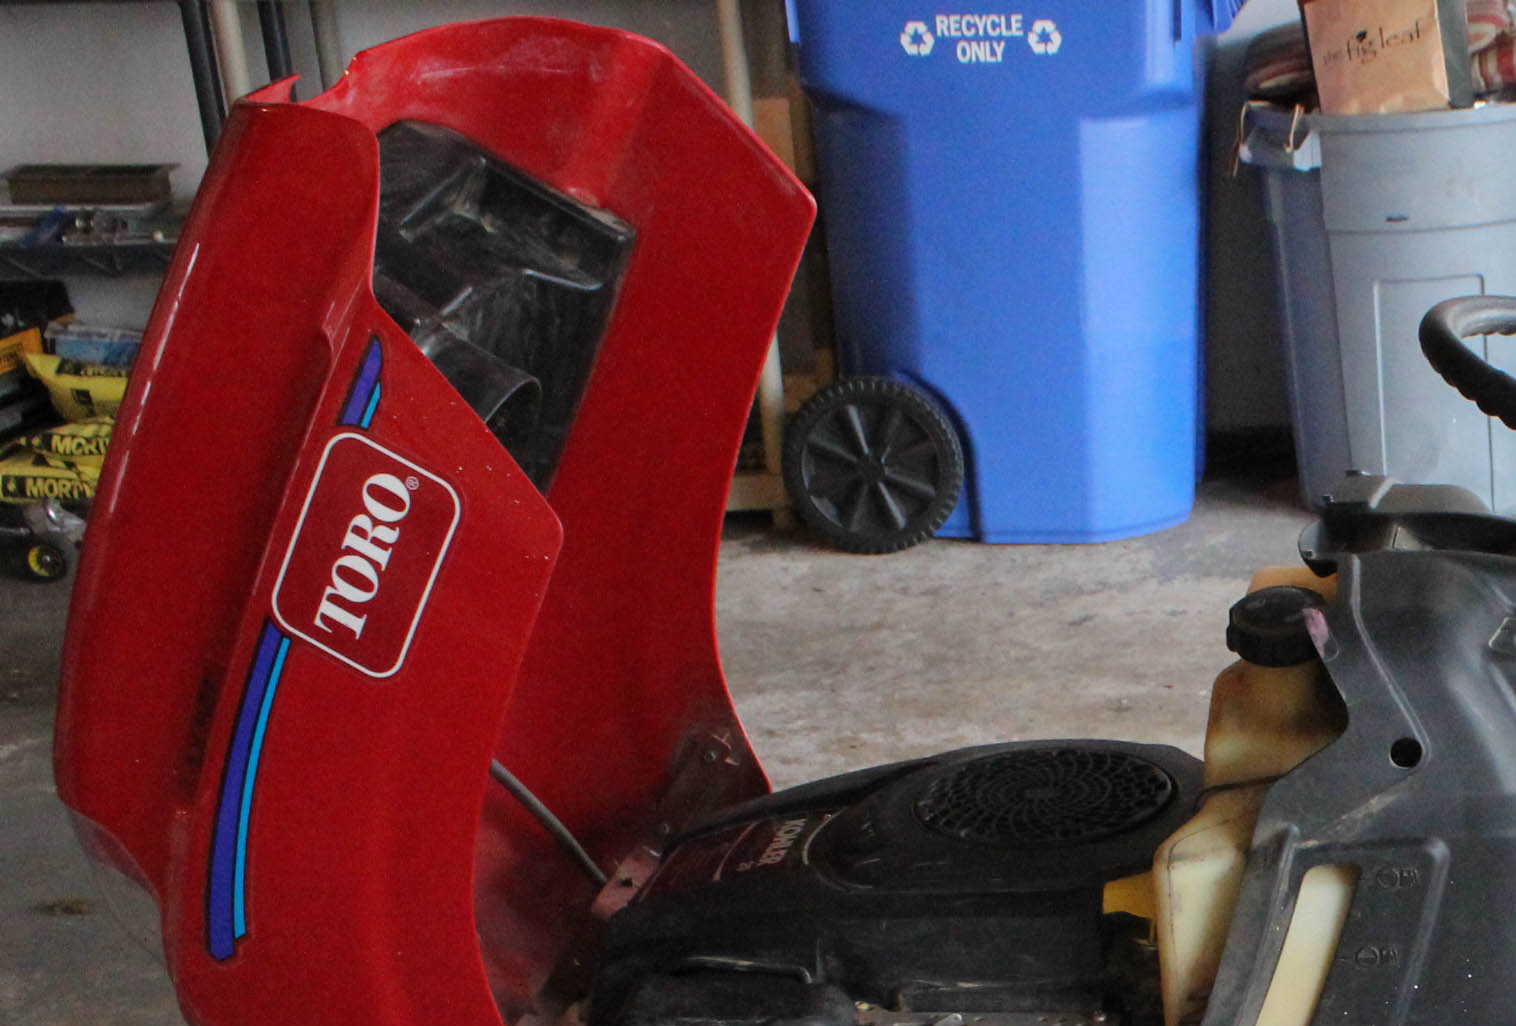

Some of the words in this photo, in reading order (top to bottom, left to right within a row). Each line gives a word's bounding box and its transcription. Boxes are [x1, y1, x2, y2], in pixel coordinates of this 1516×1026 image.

[936, 14, 1023, 37] RECYCLE
[1378, 19, 1424, 49] leaf
[957, 40, 1005, 63] ONLY
[313, 472, 411, 640] TORO
